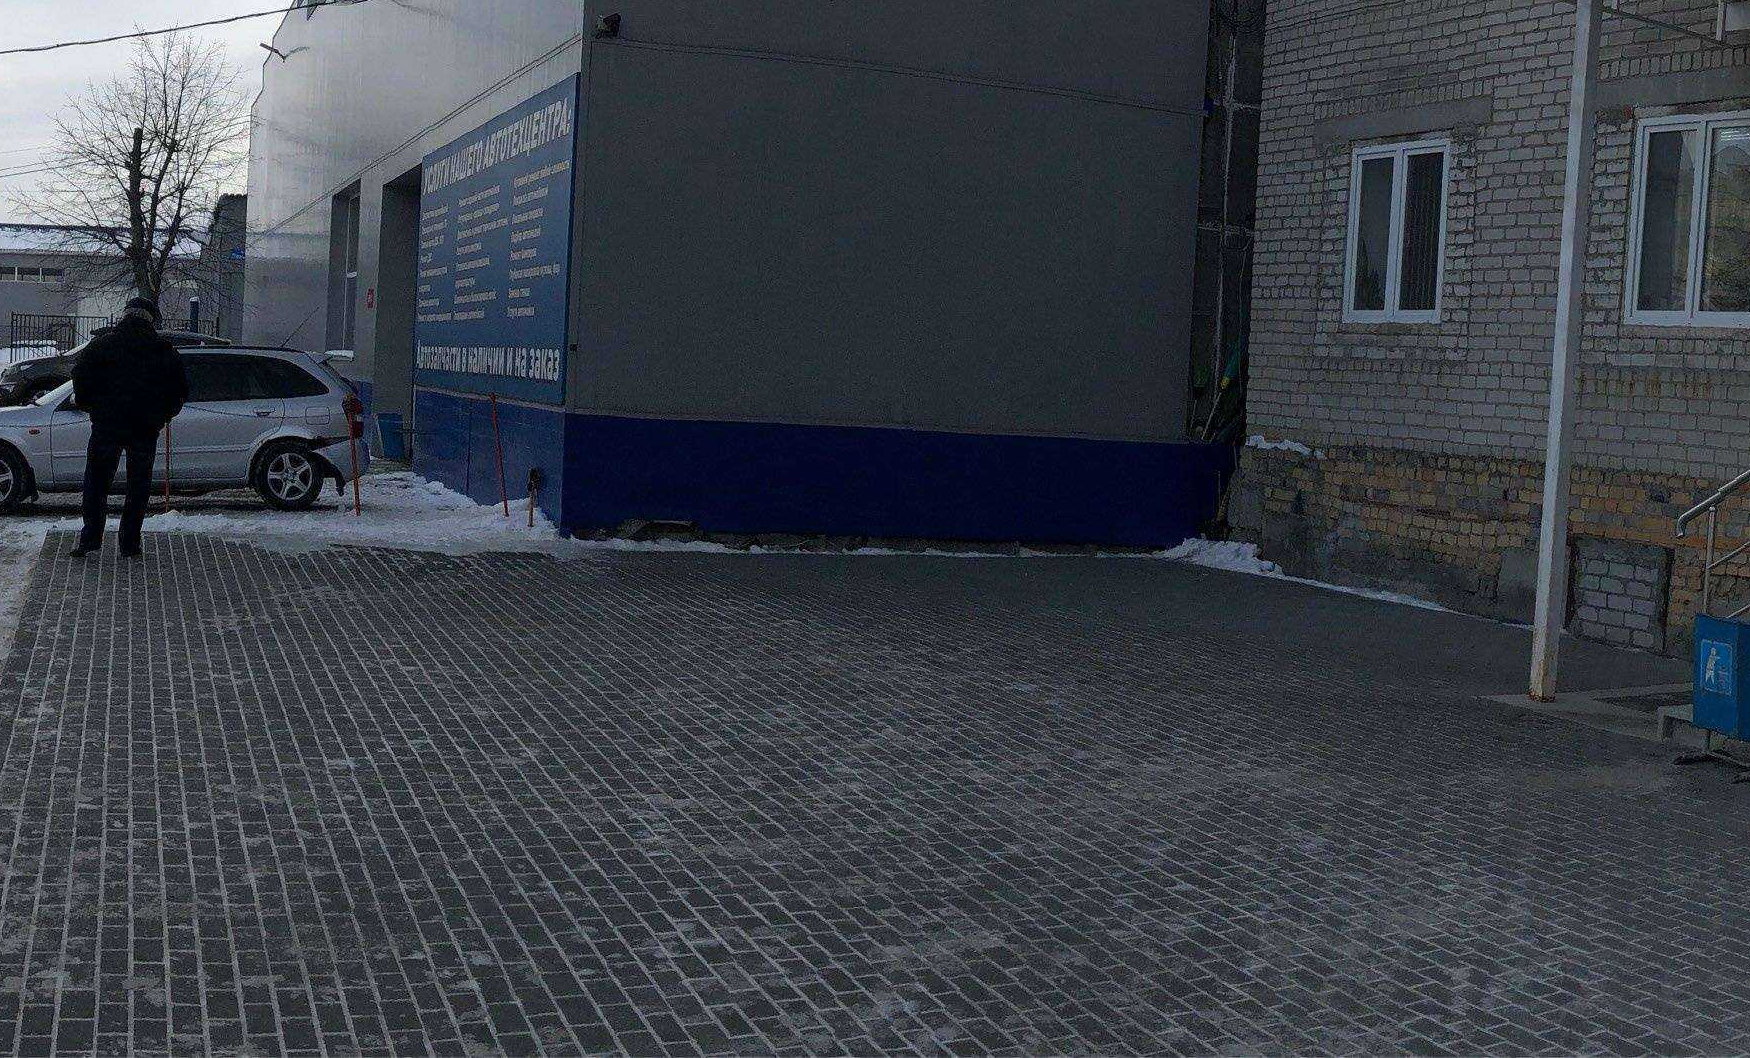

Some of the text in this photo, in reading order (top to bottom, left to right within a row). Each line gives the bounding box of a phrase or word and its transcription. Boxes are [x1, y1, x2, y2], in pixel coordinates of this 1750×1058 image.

[468, 347, 504, 376] наличии
[506, 347, 513, 376] и
[515, 347, 527, 378] на
[528, 348, 560, 382] заказ
